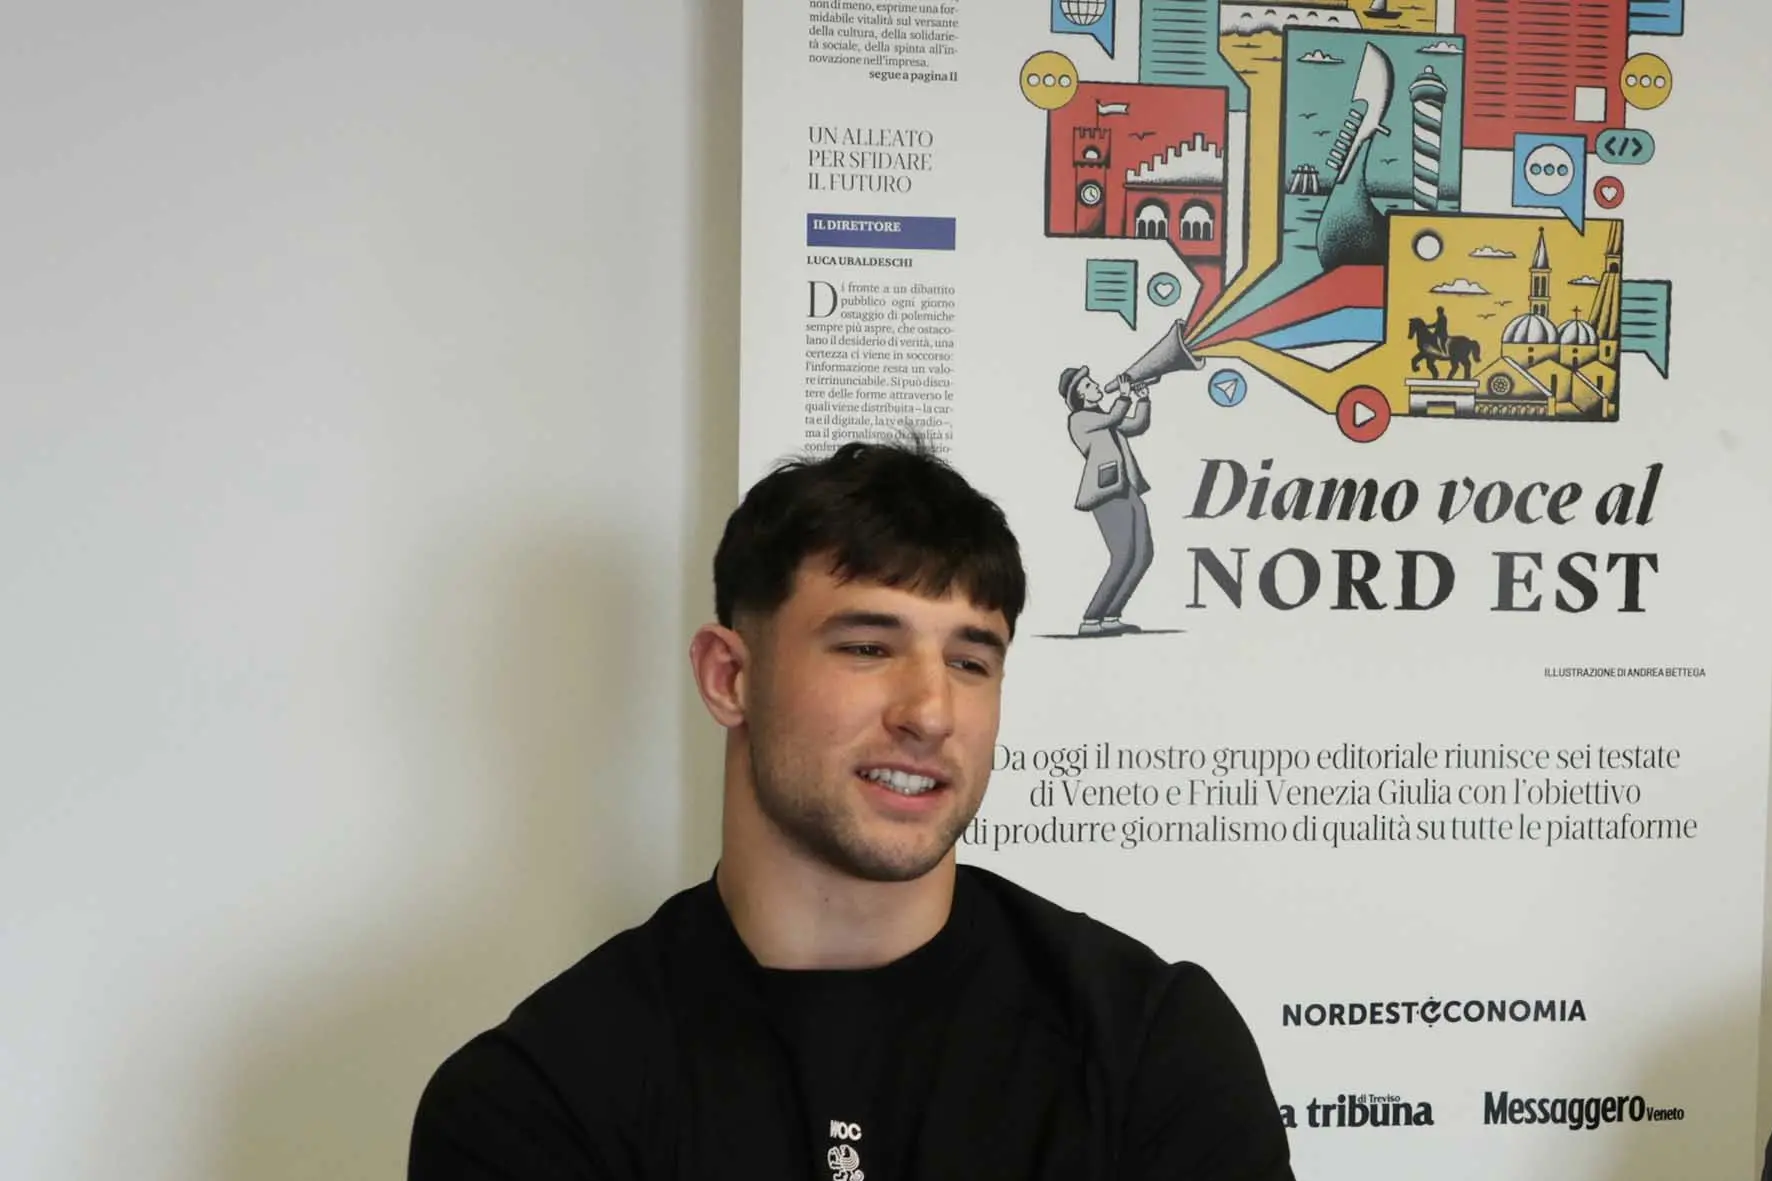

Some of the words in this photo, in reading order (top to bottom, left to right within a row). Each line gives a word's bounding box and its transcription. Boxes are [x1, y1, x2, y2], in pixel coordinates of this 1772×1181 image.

[809, 26, 834, 36] della
[881, 29, 907, 40] della
[869, 69, 901, 82] segue
[903, 72, 909, 80] a
[910, 71, 947, 83] pagina
[808, 126, 838, 145] UN
[842, 128, 934, 148] ALLEATO
[808, 149, 845, 168] PER
[849, 151, 932, 171] SFIDARE
[808, 172, 826, 190] IL
[830, 173, 912, 193] FUTURO
[814, 219, 826, 230] IL
[828, 220, 901, 232] DIRETTORE
[807, 256, 837, 265] LUCA
[1183, 458, 1419, 522] Diamo
[1438, 476, 1583, 525] voce
[1595, 462, 1664, 526] al
[1185, 547, 1455, 611] NORD
[1490, 551, 1659, 613] EST
[1544, 667, 1615, 677] ILLUSTRAZIONE
[1627, 667, 1664, 677] ANDREA
[991, 744, 1025, 771] Da
[1033, 744, 1088, 777] oggi
[1097, 742, 1109, 770] il
[1118, 746, 1206, 770] nostro
[1212, 748, 1310, 777] gruppo
[1316, 742, 1438, 770] editoriale
[1445, 743, 1550, 769] riunisce
[1556, 743, 1591, 769] sei
[1598, 744, 1681, 769] testate
[1030, 780, 1053, 807] di
[1061, 779, 1158, 806] Veneto
[1166, 785, 1181, 806] e
[1188, 778, 1257, 806] Friuli
[1265, 779, 1370, 806] Venezia
[1378, 778, 1451, 805] Giulia
[1458, 783, 1506, 805] con
[962, 816, 987, 846] di
[994, 816, 1116, 851] produrre
[1121, 815, 1287, 850] giornalismo
[1293, 814, 1316, 842] di
[1322, 814, 1411, 848] qualità
[1416, 818, 1445, 841] su
[1451, 816, 1513, 841] tutte
[1520, 814, 1541, 841] le
[1545, 813, 1698, 847] piattaforme
[1358, 1094, 1367, 1103] di
[1368, 1094, 1401, 1103] Treviso
[1280, 1103, 1298, 1128] a
[1307, 1094, 1434, 1128] tribuna
[1483, 1091, 1646, 1130] Messaggero
[1647, 1105, 1685, 1122] Veneto
